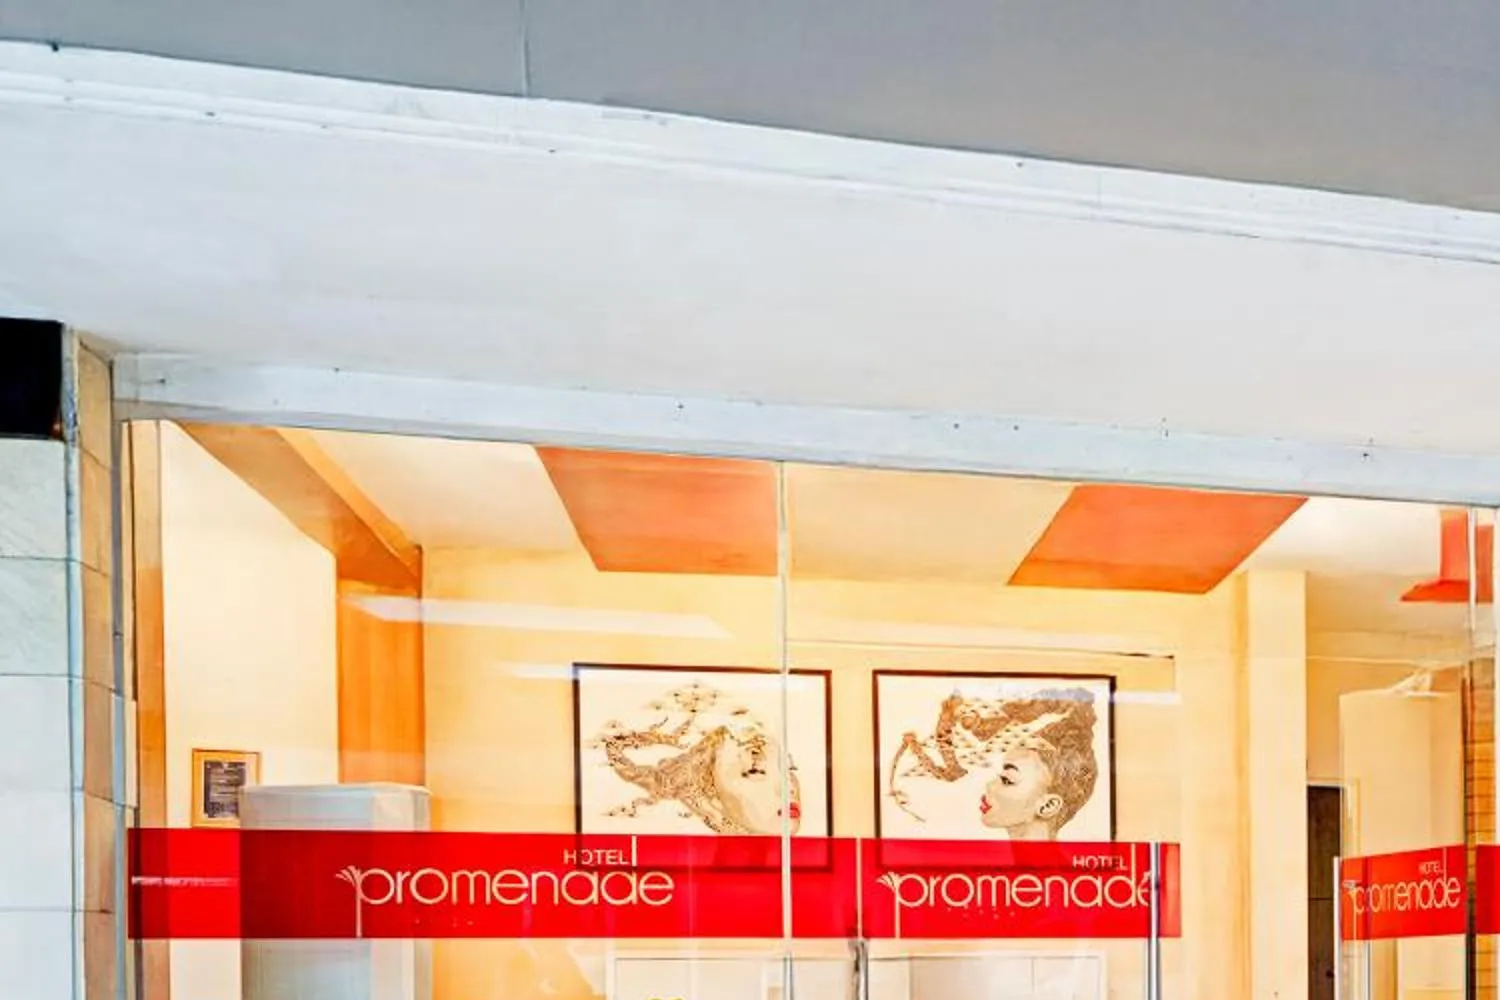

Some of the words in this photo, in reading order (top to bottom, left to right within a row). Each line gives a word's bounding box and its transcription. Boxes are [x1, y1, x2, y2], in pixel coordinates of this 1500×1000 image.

[563, 849, 630, 865] HOTEL
[1072, 855, 1128, 871] HOTEL
[335, 836, 675, 938] promenade
